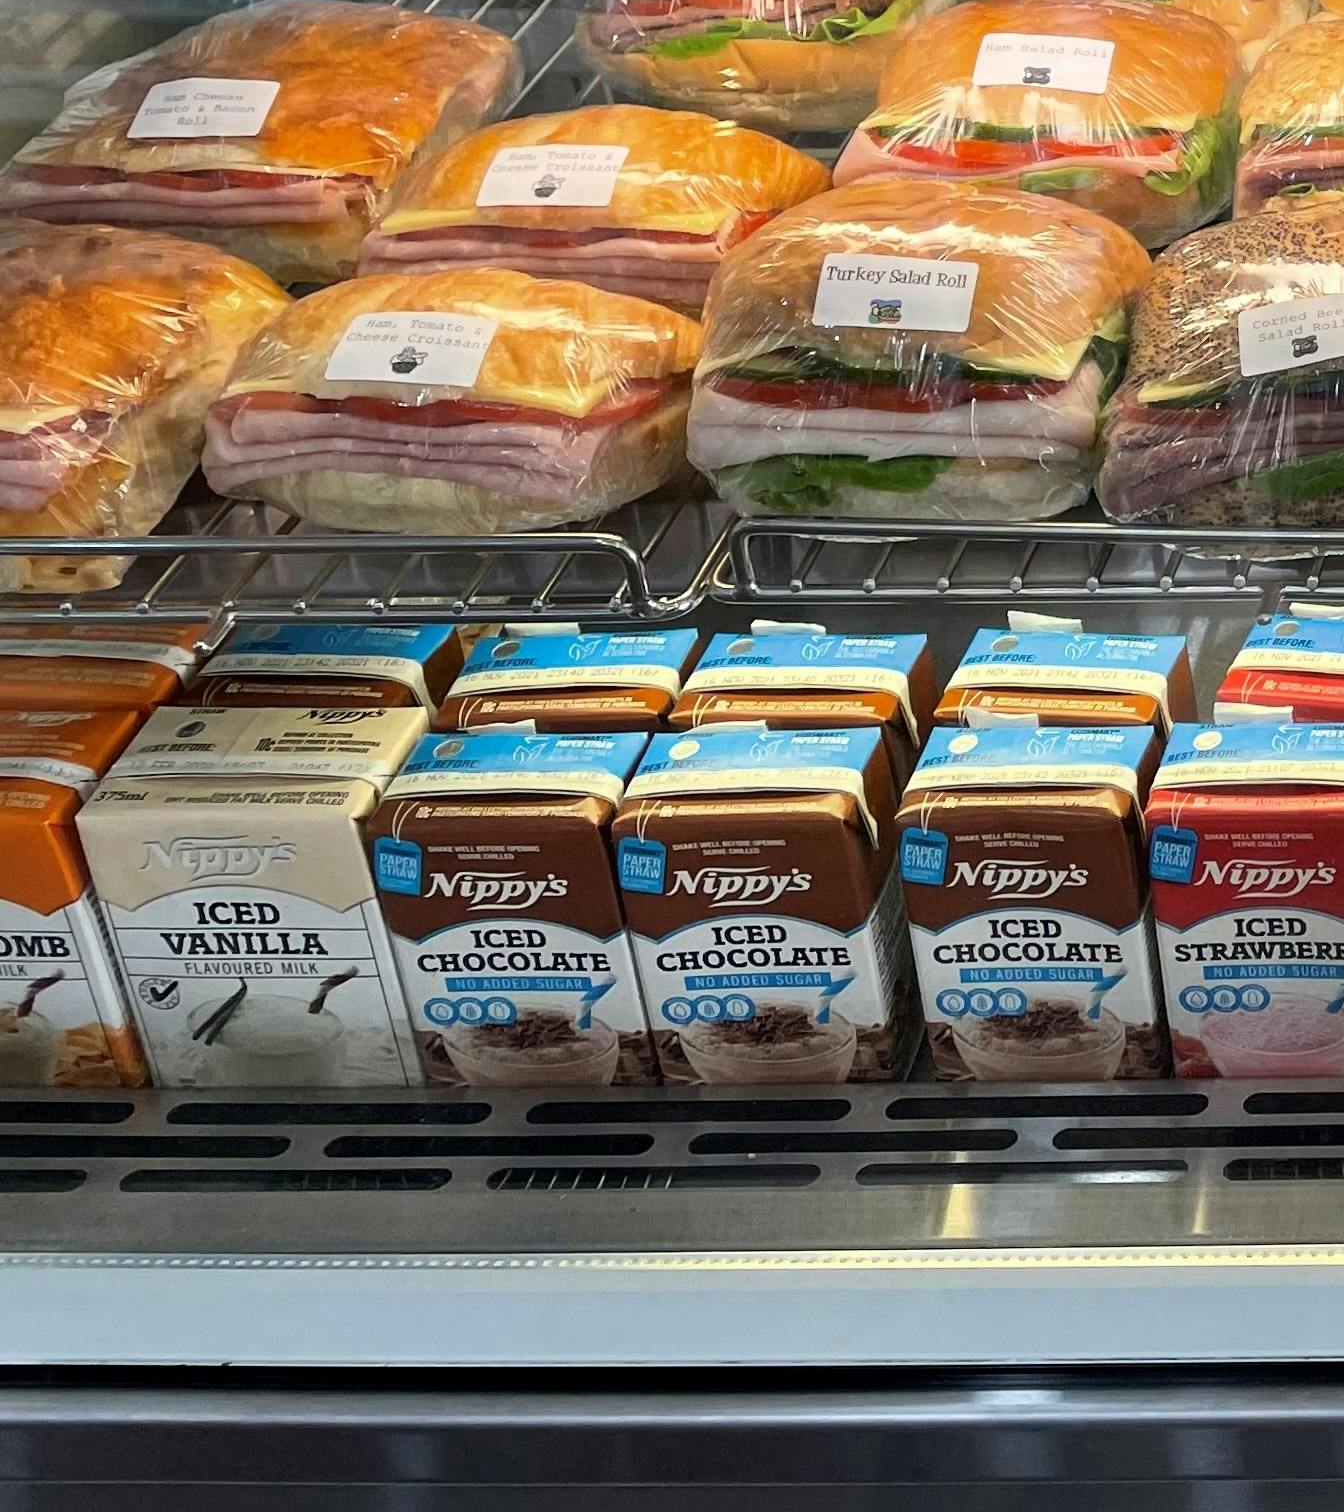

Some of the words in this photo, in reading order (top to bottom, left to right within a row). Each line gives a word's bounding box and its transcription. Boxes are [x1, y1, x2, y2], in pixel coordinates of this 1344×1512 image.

[827, 266, 884, 283] Turkey
[890, 270, 931, 286] Salad
[937, 273, 967, 288] Roll
[410, 319, 463, 333] Tomato
[1253, 311, 1308, 330] Corned
[347, 331, 398, 342] Cheese
[407, 333, 489, 350] Croissant
[1258, 327, 1308, 343] Salad
[94, 791, 150, 802] 375ml
[140, 835, 297, 880] Nippy's
[905, 845, 942, 859] PAPER
[1154, 841, 1191, 857] PAPER
[380, 853, 417, 869] PAPER
[623, 854, 661, 868] PAPER
[905, 855, 941, 869] STRAW
[1153, 853, 1189, 867] STRAW
[380, 866, 418, 880] STRAW
[623, 866, 660, 878] STRAW
[947, 860, 1088, 899] Nippy's
[1194, 860, 1336, 899] Nippy's
[424, 872, 568, 910] Nippy's
[667, 866, 812, 908] Nippy's
[193, 902, 281, 924] ICED
[712, 926, 787, 945] ICED
[988, 920, 1062, 938] ICED
[1234, 918, 1307, 937] ICED
[161, 932, 328, 956] VANILLA
[471, 930, 546, 948] ICED
[657, 947, 851, 971] CHOCOLATE
[933, 943, 1123, 963] CHOCOLATE
[185, 960, 273, 975] FLAVOURED
[281, 961, 318, 974] MILK
[418, 953, 611, 972] CHOCOLATE
[1213, 967, 1233, 977] NO
[1241, 966, 1285, 976] ADDED
[1293, 966, 1337, 976] SUGAR
[695, 976, 715, 987] NO
[722, 975, 769, 986] ADDED
[777, 974, 822, 985] SUGAR
[970, 970, 989, 980] NO
[997, 969, 1042, 980] ADDED
[1049, 969, 1094, 980] SUGAR
[456, 979, 475, 990] NO
[483, 979, 529, 990] ADDED
[537, 978, 582, 989] SUGAR
